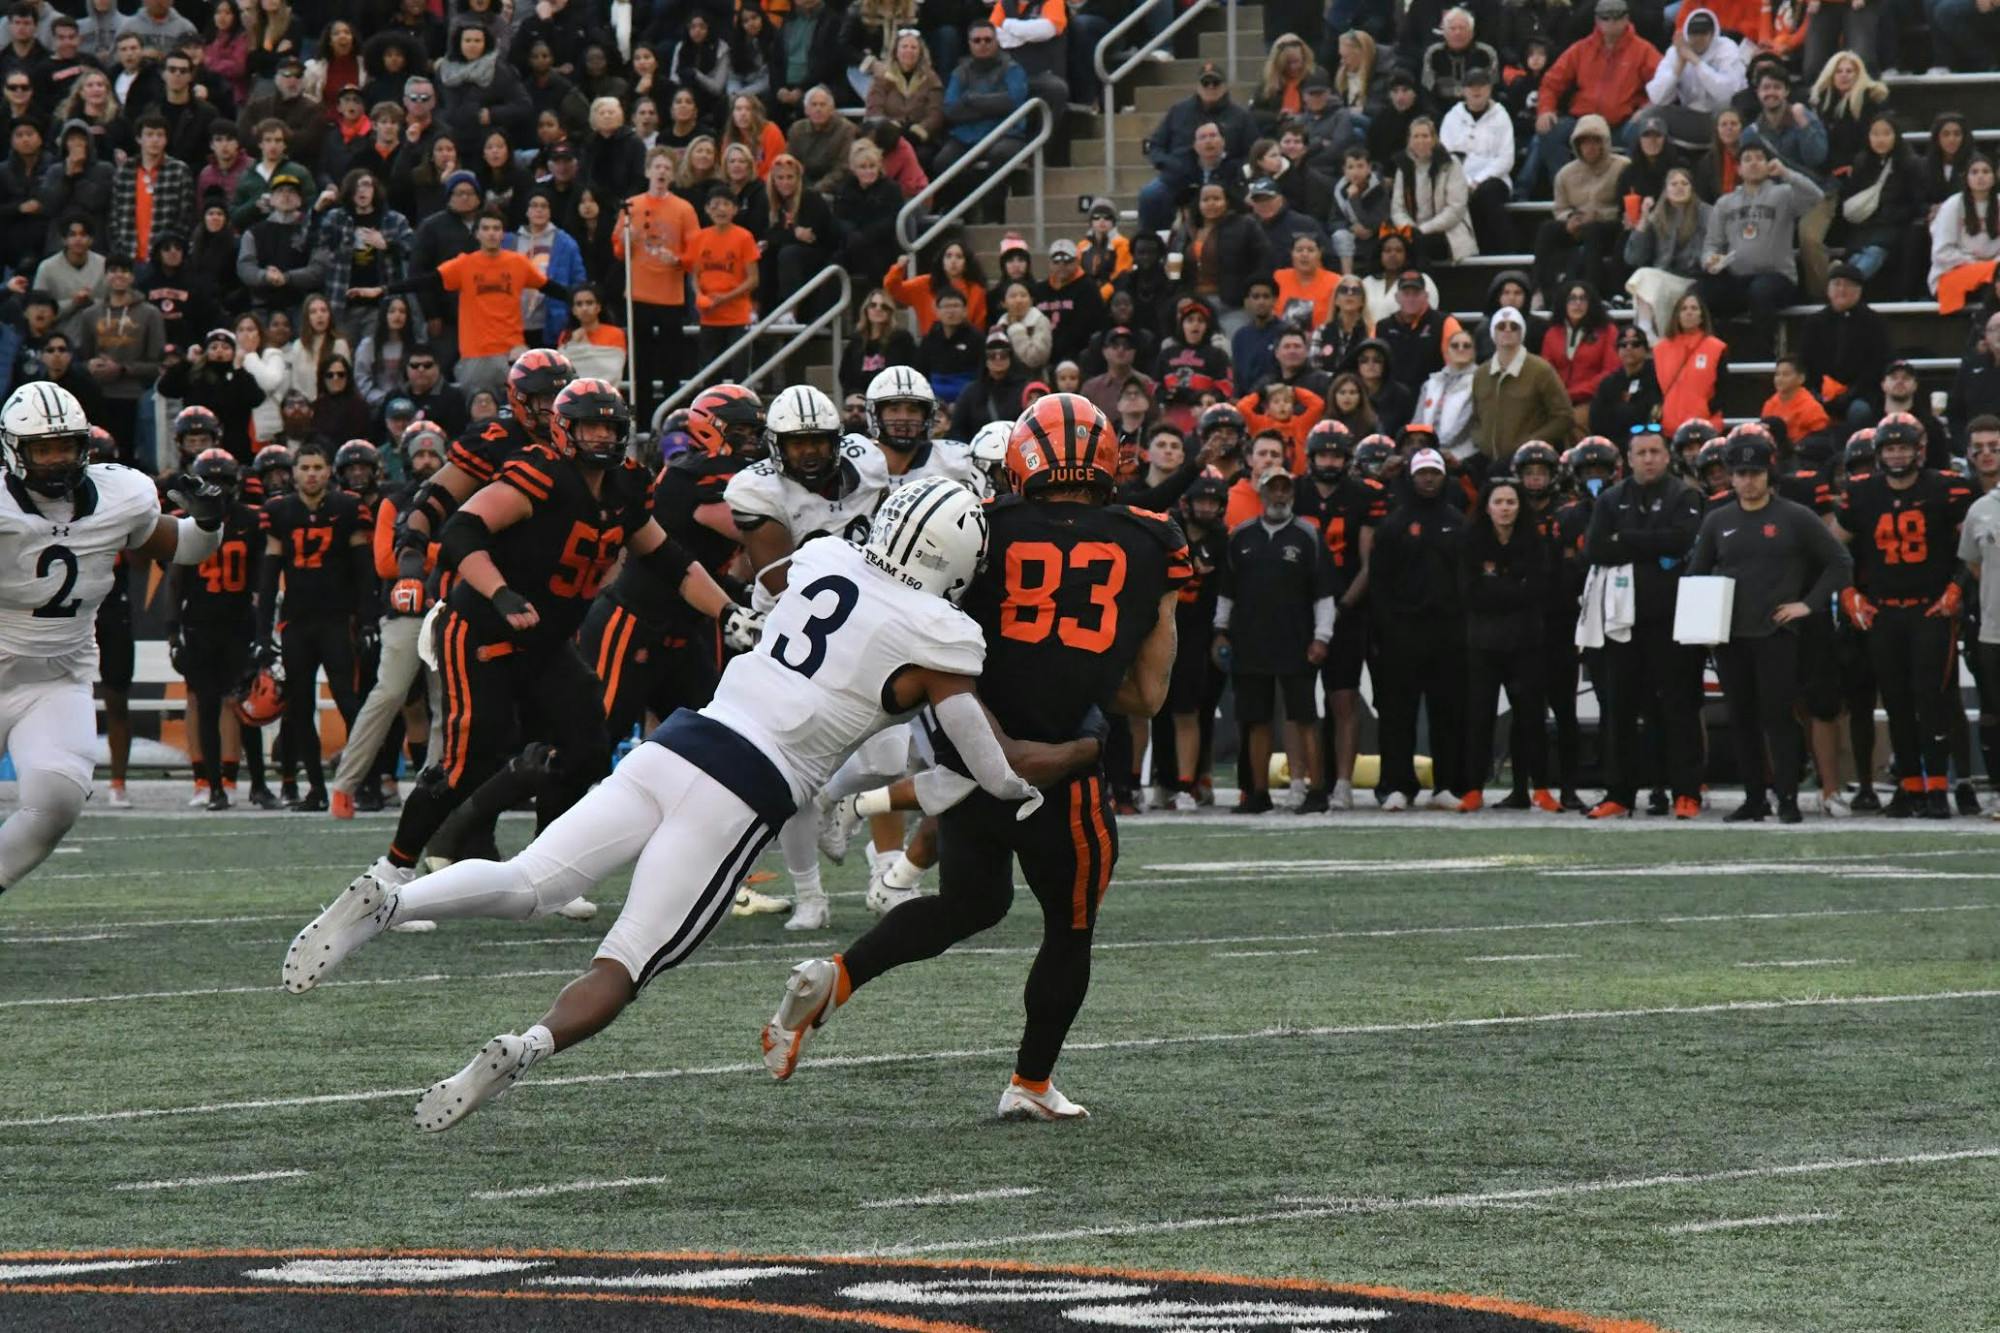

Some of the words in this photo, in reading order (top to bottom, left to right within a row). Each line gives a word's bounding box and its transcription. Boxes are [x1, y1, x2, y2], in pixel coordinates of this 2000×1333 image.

[1048, 468, 1096, 482] JUICE
[291, 527, 333, 568] 17
[915, 550, 923, 558] 3
[1874, 510, 1928, 565] 48
[32, 544, 83, 618] 2
[200, 540, 247, 592] 40
[865, 548, 899, 578] TEAM
[900, 573, 923, 591] 150
[1000, 541, 1127, 654] 83
[771, 574, 860, 680] 3
